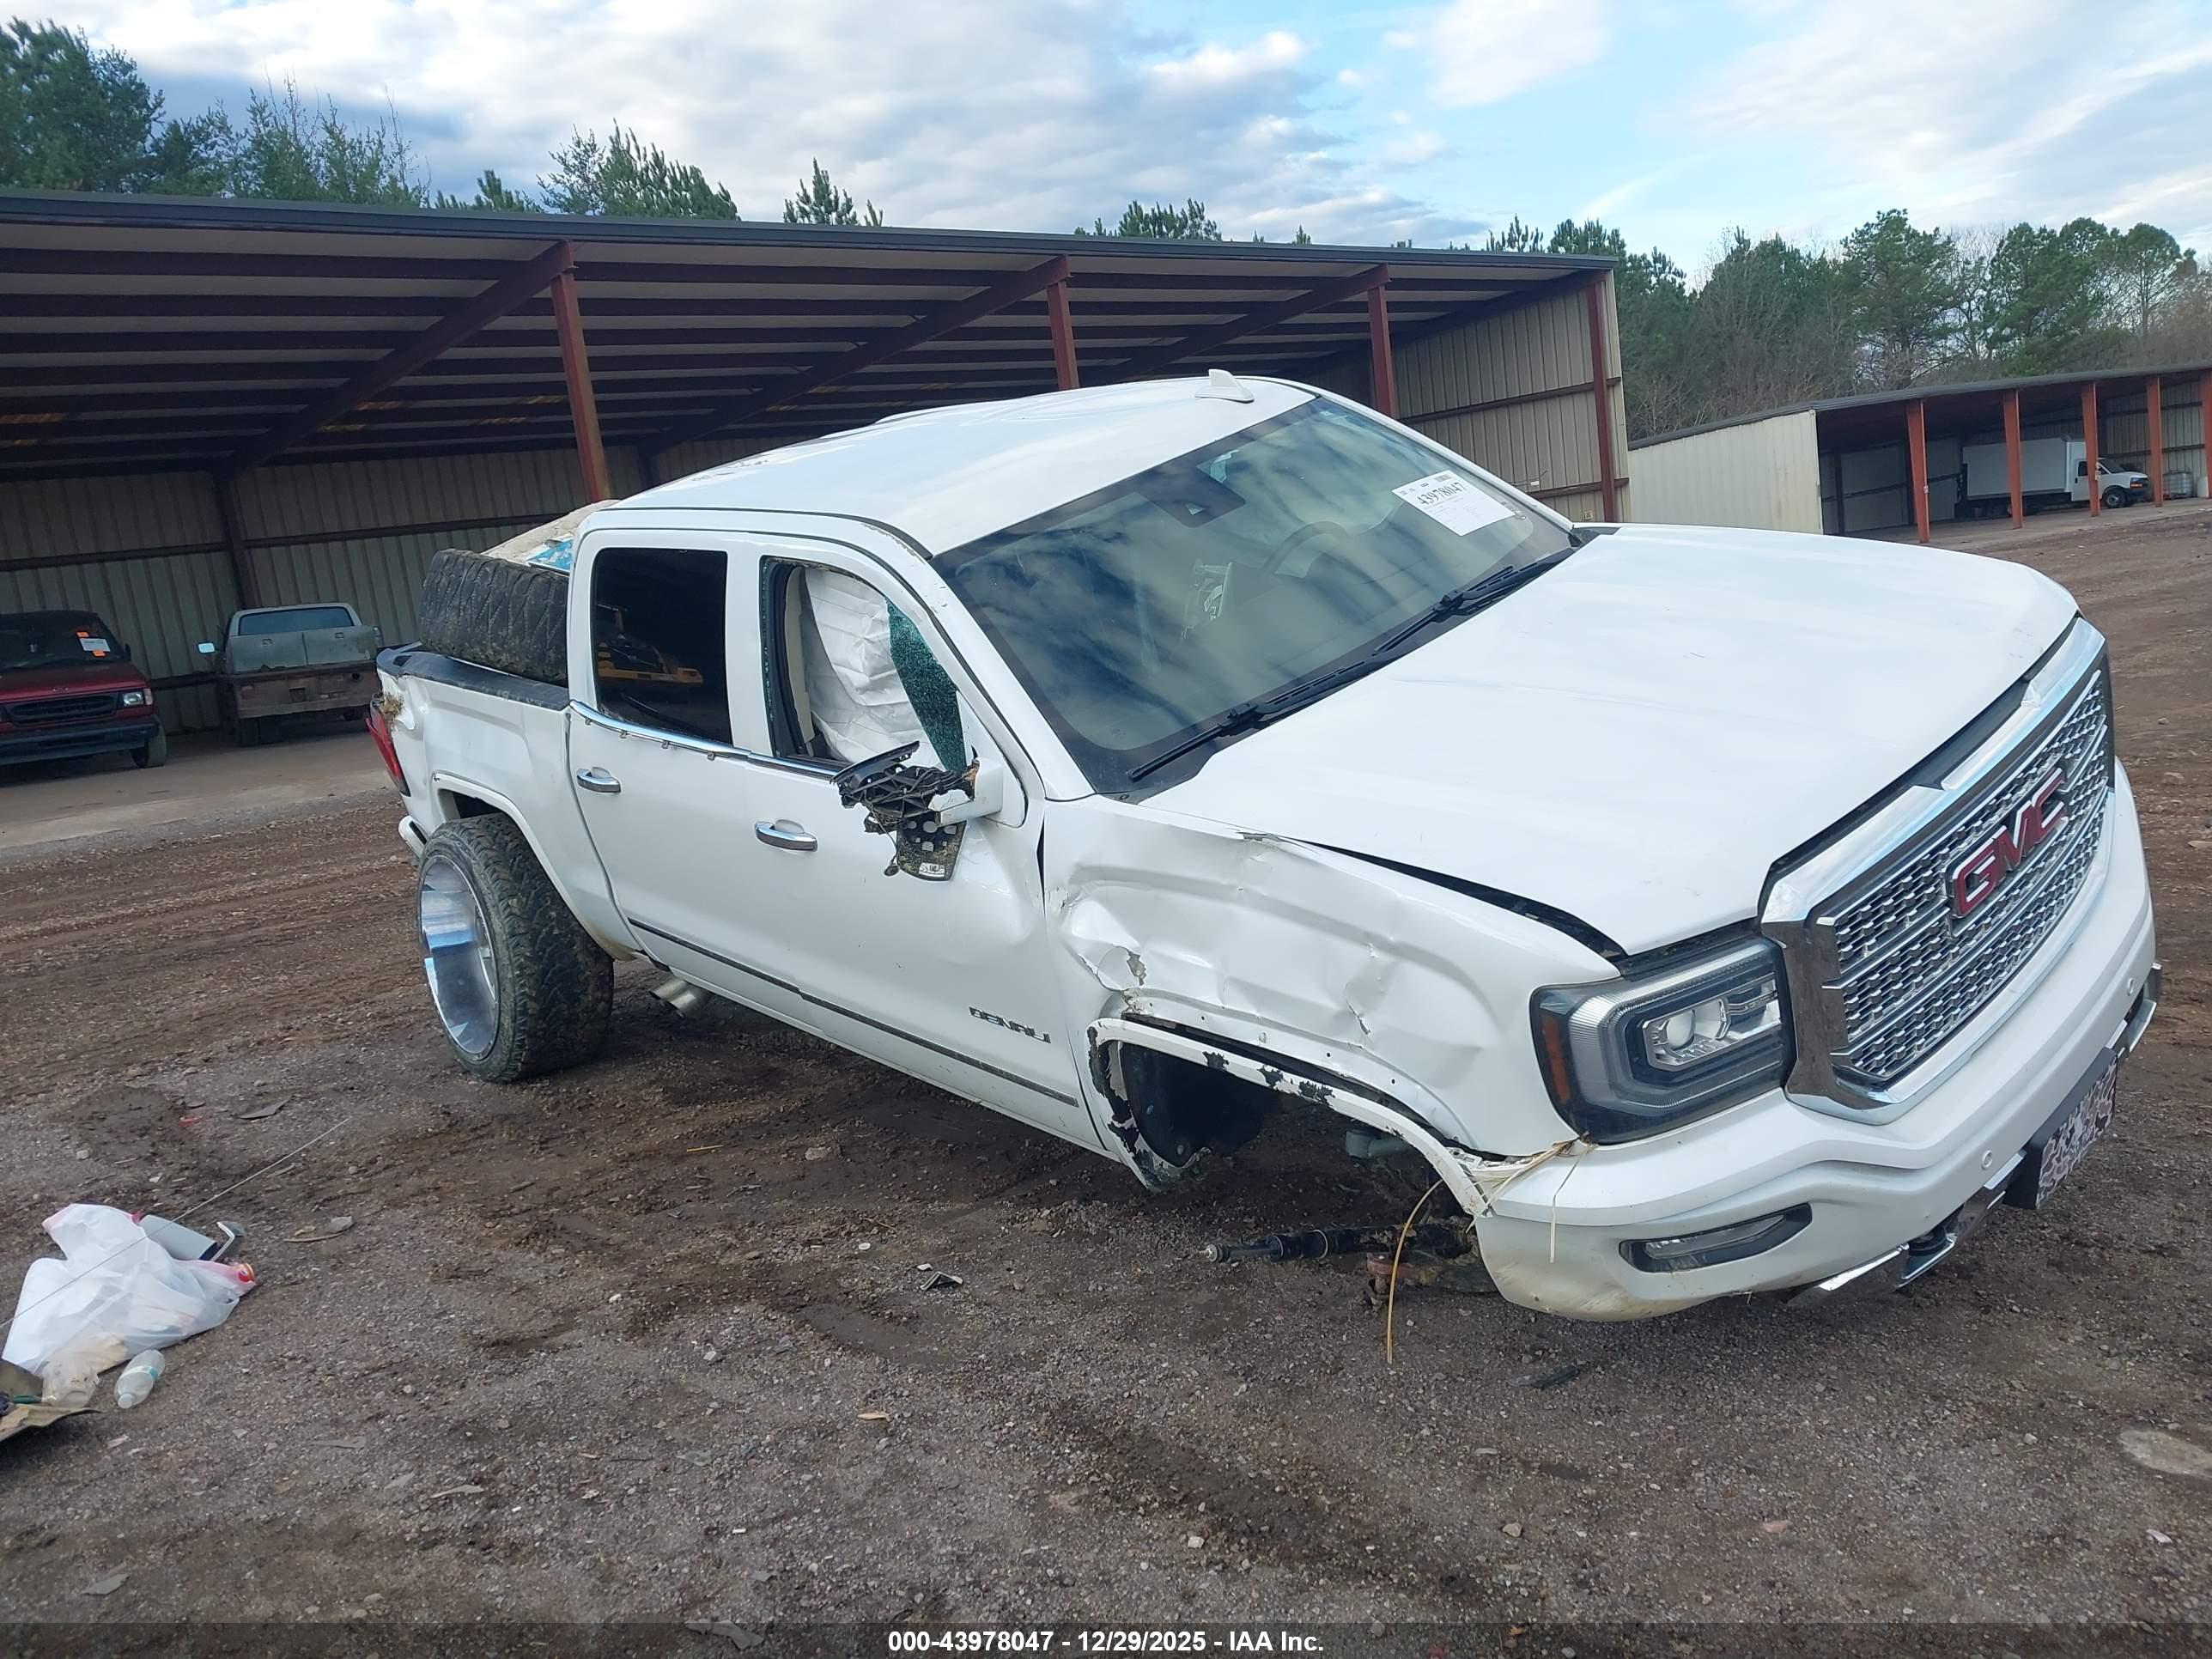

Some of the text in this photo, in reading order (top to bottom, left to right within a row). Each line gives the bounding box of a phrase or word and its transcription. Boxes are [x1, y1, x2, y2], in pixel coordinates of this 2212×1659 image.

[1416, 482, 1467, 505] 43978047
[1948, 766, 2069, 919] GMC
[968, 1006, 1052, 1044] DENALI
